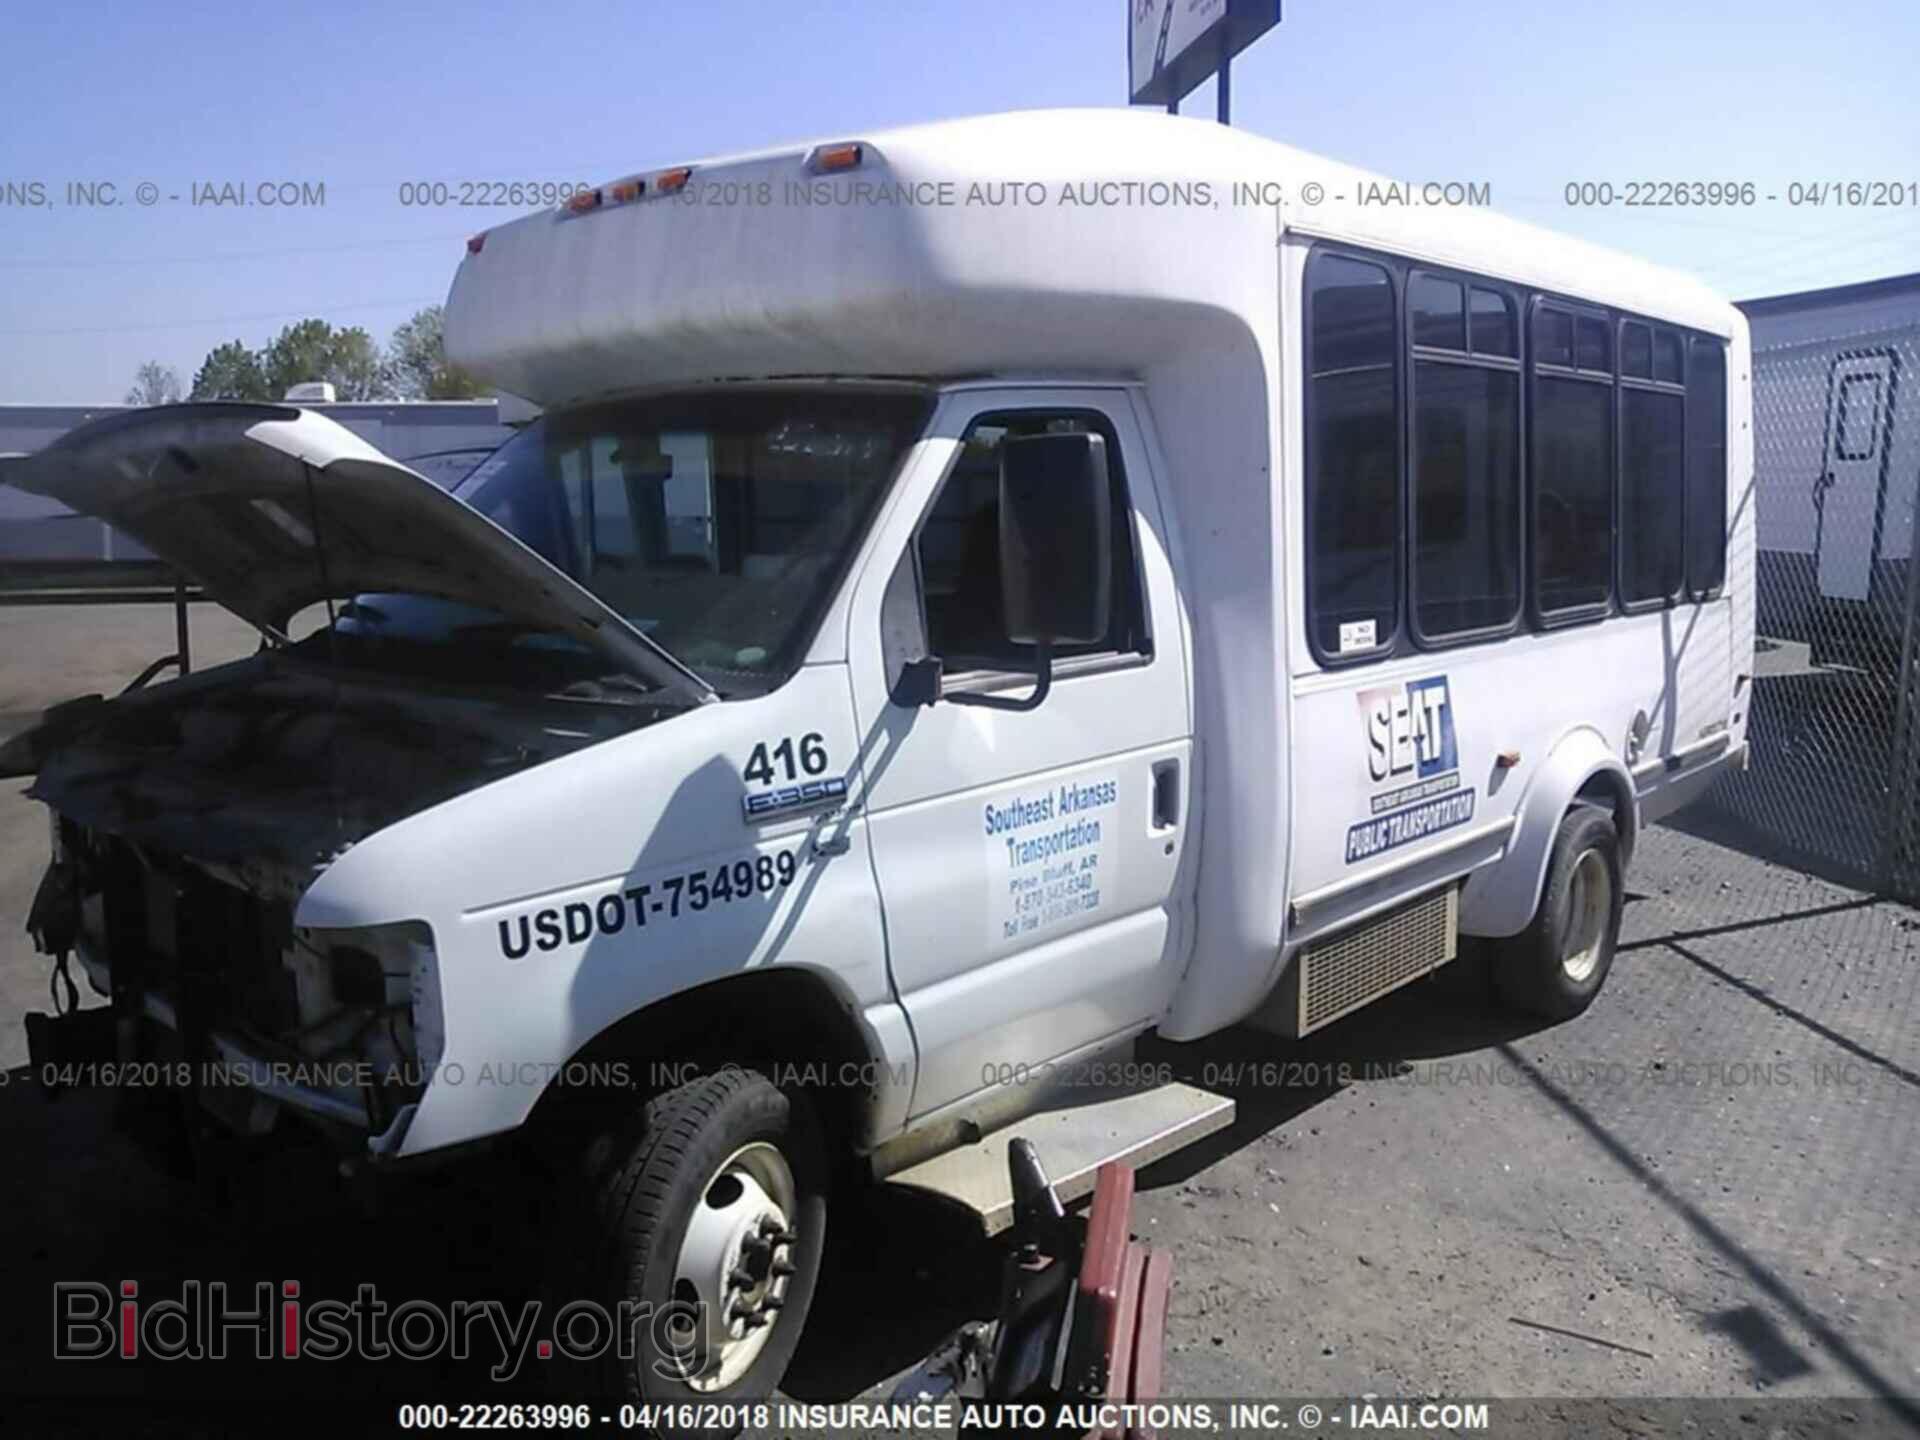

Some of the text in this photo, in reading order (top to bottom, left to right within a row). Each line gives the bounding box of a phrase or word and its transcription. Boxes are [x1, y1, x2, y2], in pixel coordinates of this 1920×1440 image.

[744, 732, 827, 785] 416
[1369, 686, 1446, 782] SEAT
[985, 781, 1117, 835] Southeast Arkansas
[1348, 816, 1389, 861] PUBLIC
[1388, 789, 1473, 846] TRANSPORTATION
[1006, 818, 1100, 868] Transportation
[1080, 853, 1098, 870] AR
[499, 850, 797, 960] USDOT-754989
